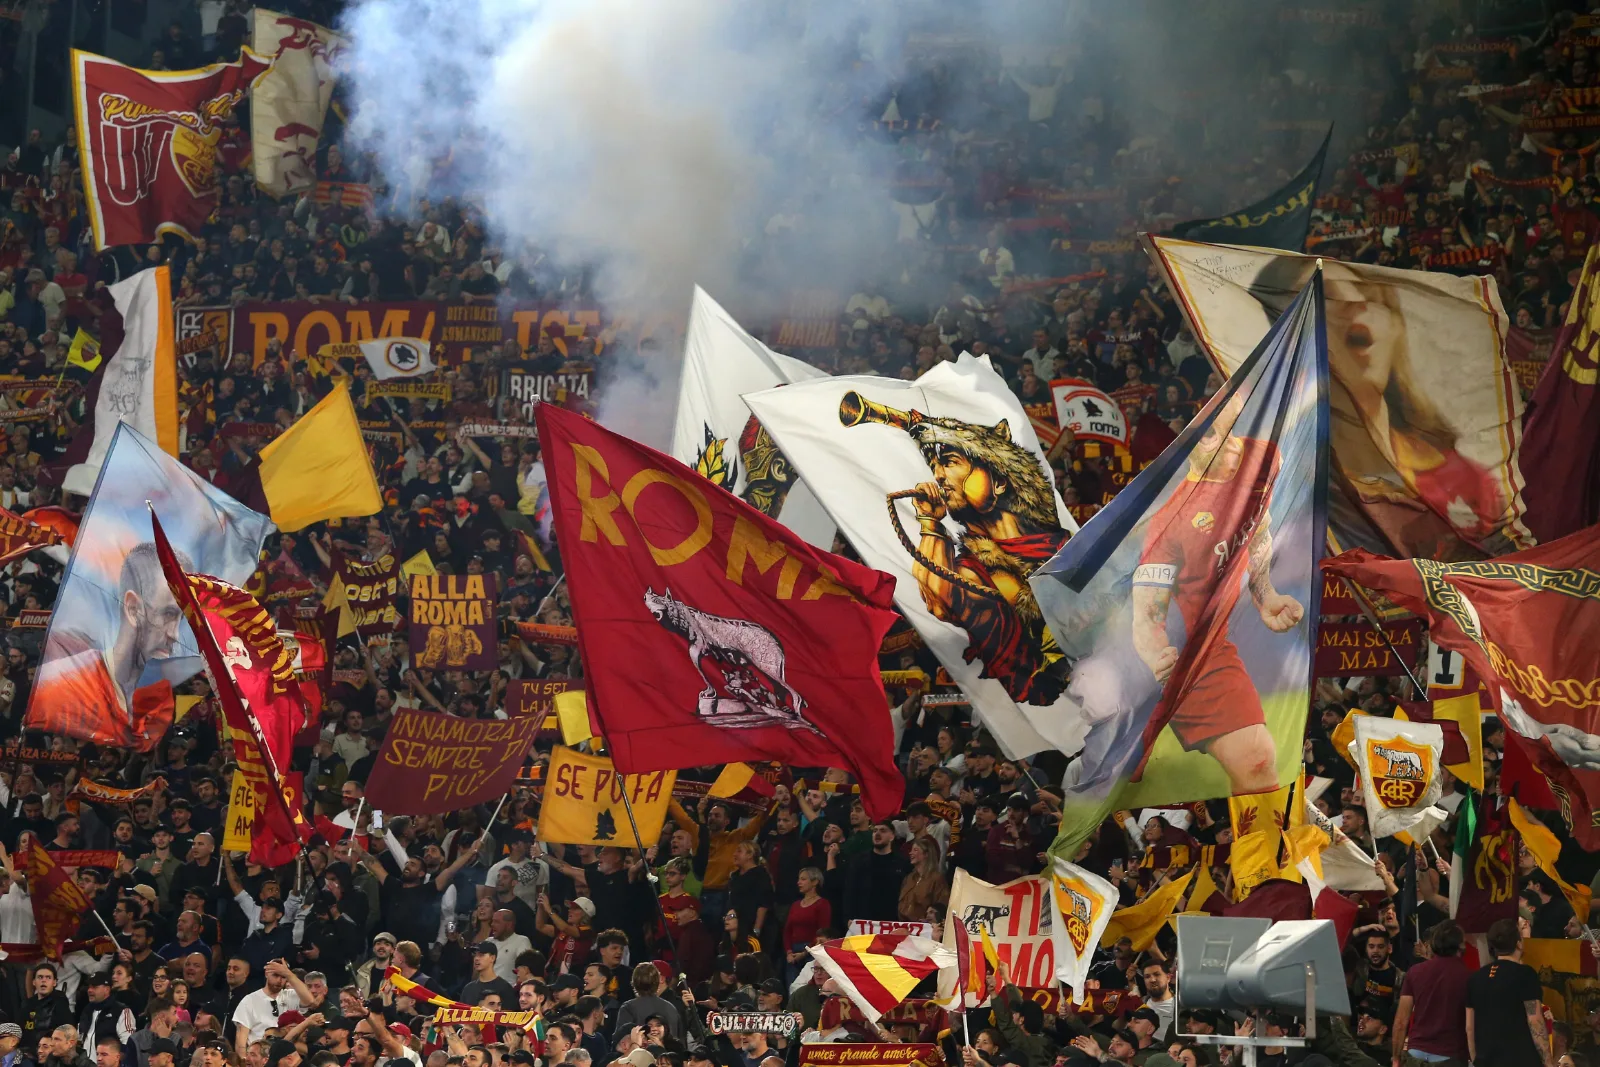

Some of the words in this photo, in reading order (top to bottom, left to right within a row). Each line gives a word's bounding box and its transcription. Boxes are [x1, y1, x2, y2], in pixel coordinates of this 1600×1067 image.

[1089, 421, 1120, 437] roma
[569, 442, 870, 607] ROMA
[411, 574, 487, 600] ALLA
[412, 600, 485, 625] ROMA
[1323, 631, 1360, 647] MAI
[1364, 629, 1413, 647] SOLA
[1339, 651, 1391, 670] MAI
[520, 699, 538, 713] LA
[385, 739, 492, 769] SEMPRE
[555, 763, 587, 800] SE
[234, 815, 254, 836] AM
[1004, 880, 1042, 937] TI
[807, 1048, 836, 1060] unico
[839, 1045, 879, 1061] grande
[882, 1048, 919, 1060] amore
